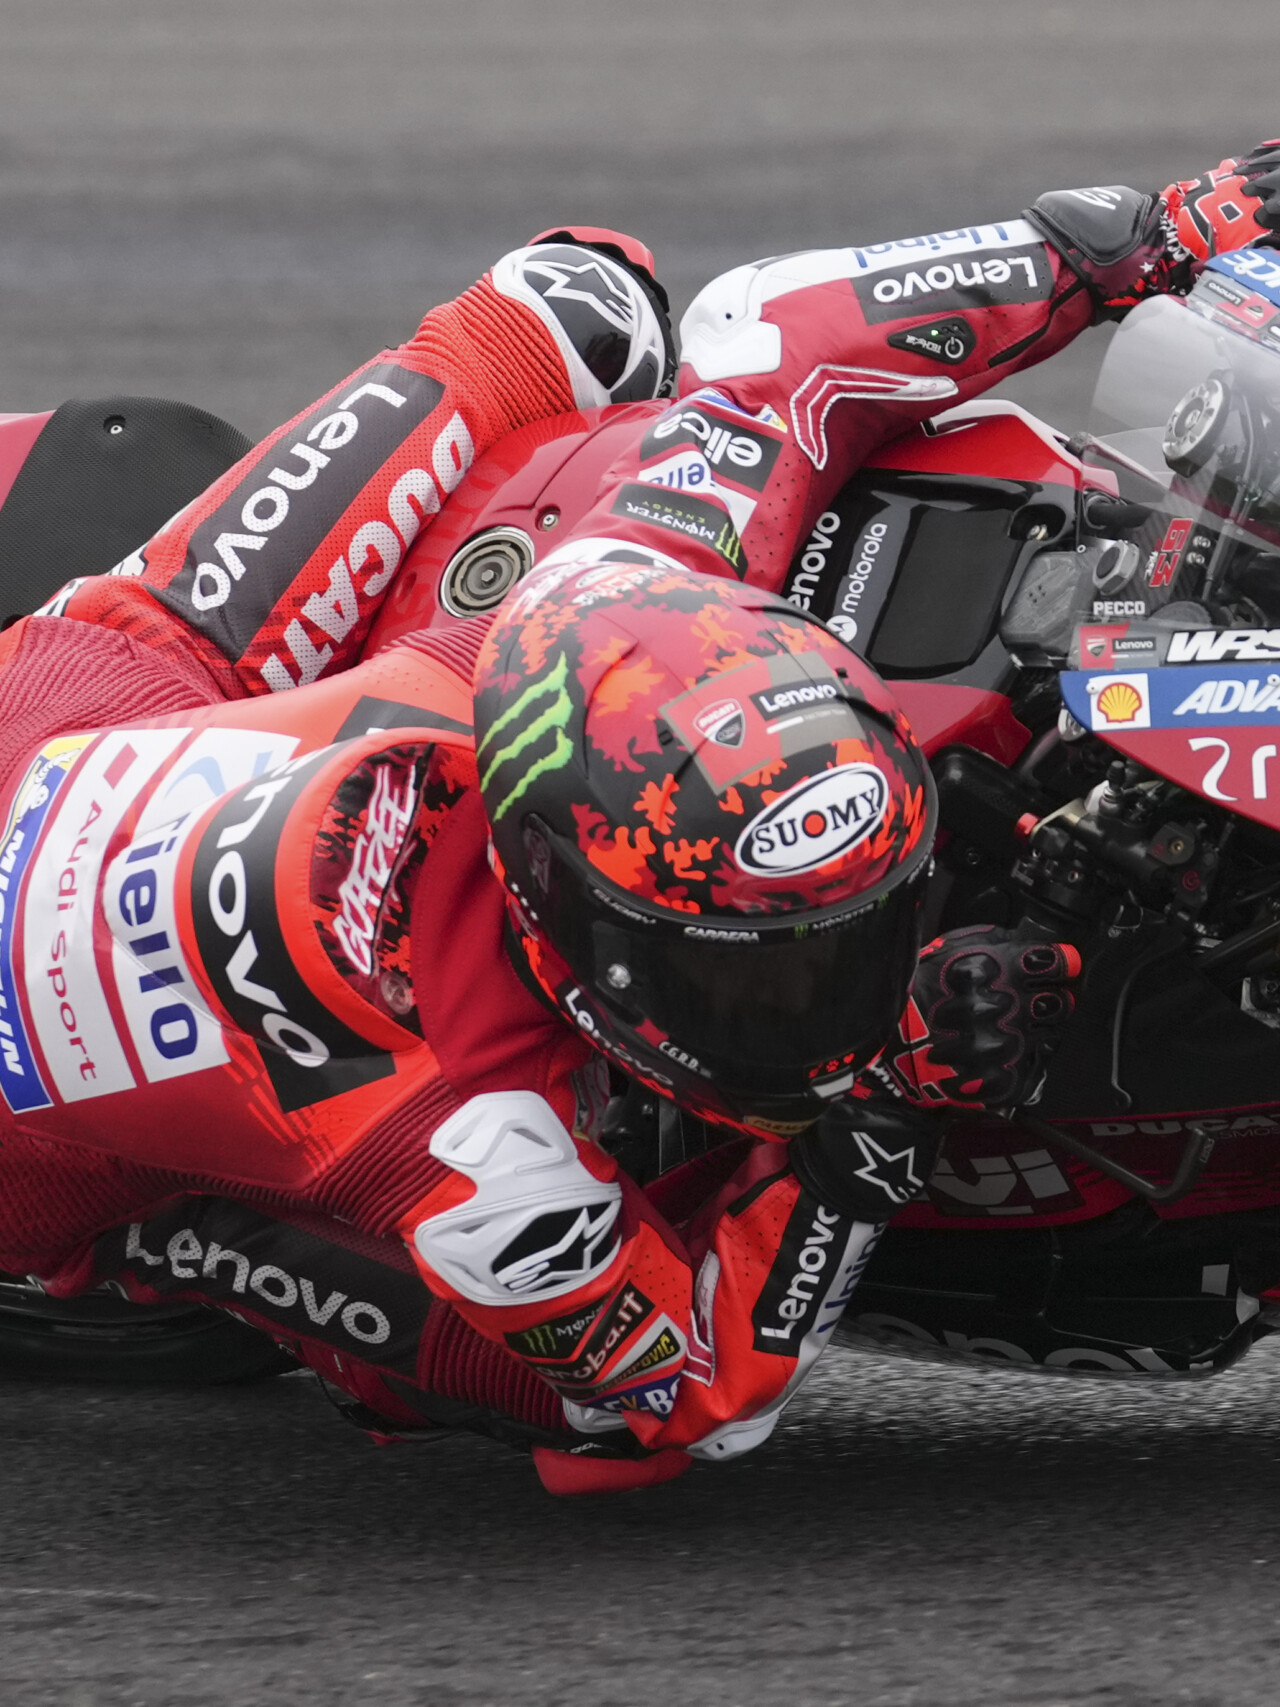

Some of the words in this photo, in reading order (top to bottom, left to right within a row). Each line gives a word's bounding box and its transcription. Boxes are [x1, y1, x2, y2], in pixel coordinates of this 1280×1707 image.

[873, 256, 1038, 302] Lenovo
[653, 411, 762, 467] elica
[191, 382, 406, 611] Lenovo
[626, 502, 716, 541] MONSTER
[642, 501, 705, 524] ENERGY
[260, 410, 474, 692] DUCATI
[787, 511, 841, 611] enovo
[841, 523, 888, 613] motorola
[1093, 601, 1145, 615] PECCO
[1115, 640, 1154, 650] Lenovo
[759, 684, 837, 712] Lenovo
[754, 787, 881, 855] SUOMY
[57, 799, 103, 911] Audi
[684, 926, 760, 943] CARRERA
[126, 1222, 391, 1344] Lenovo
